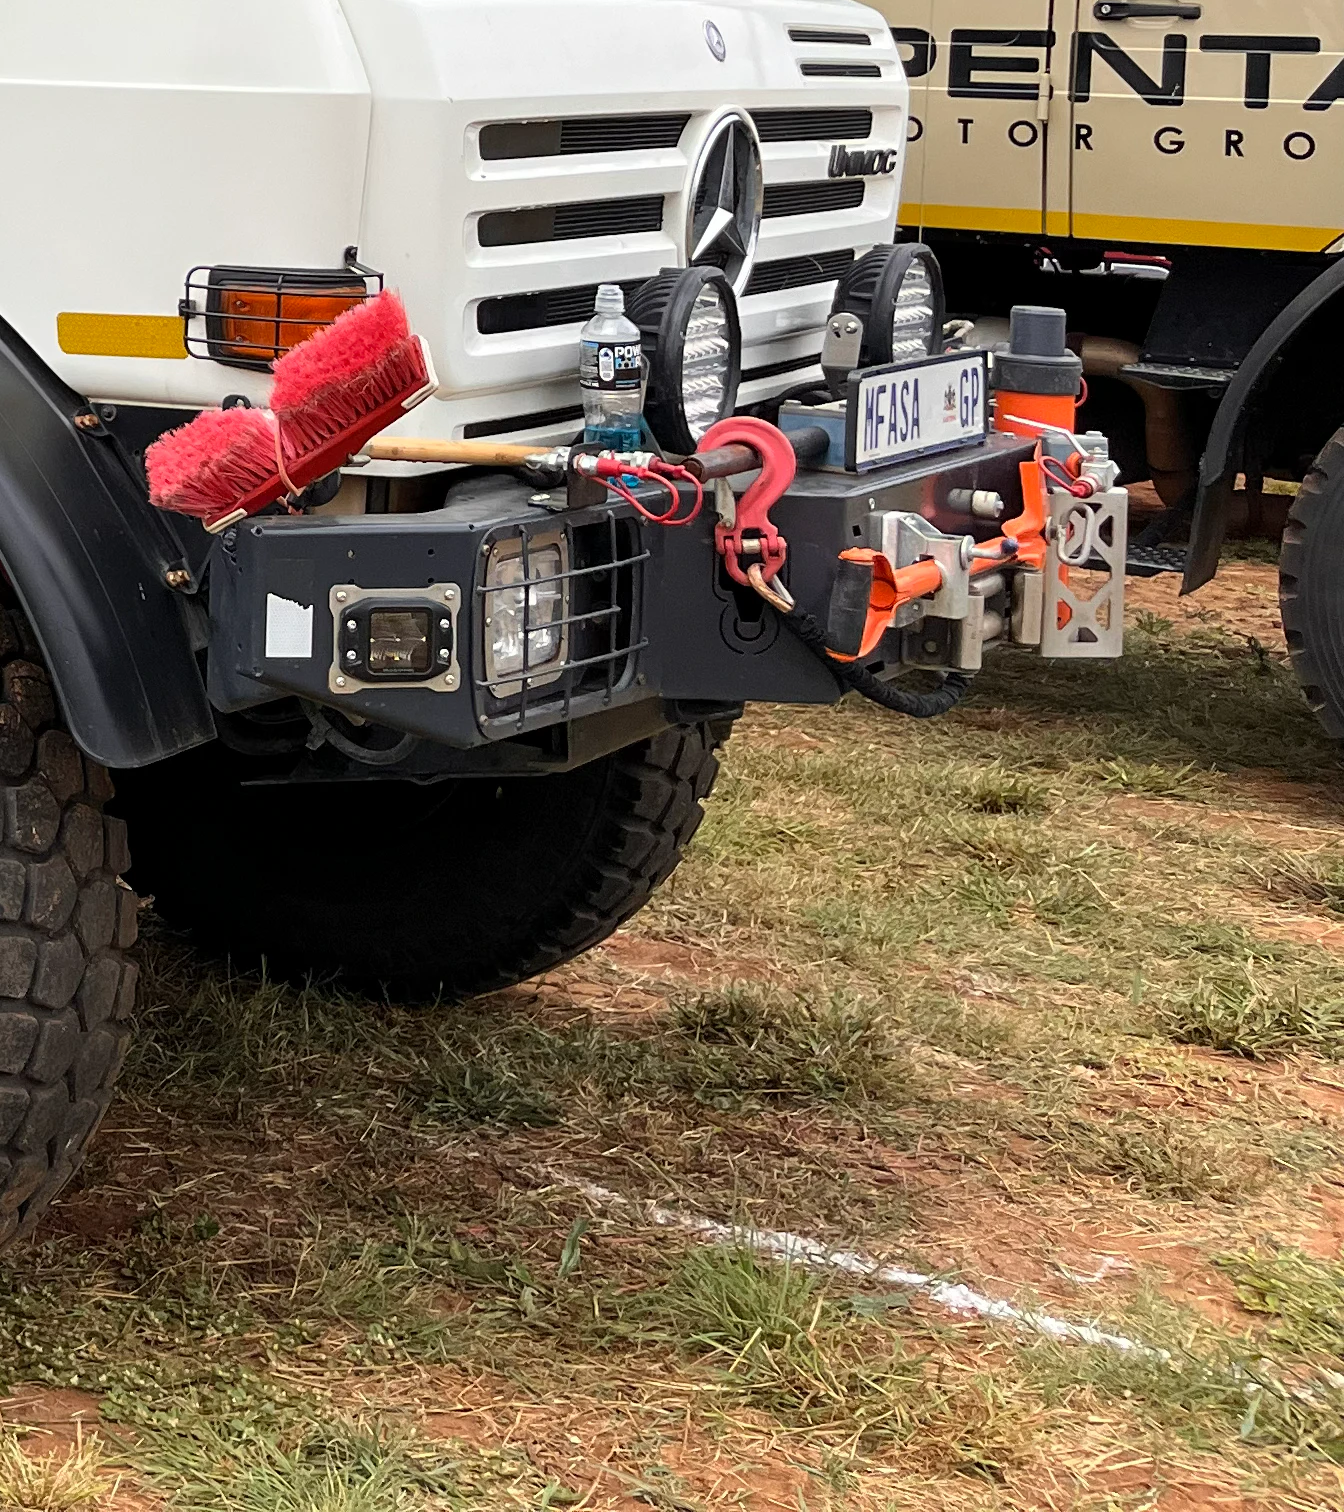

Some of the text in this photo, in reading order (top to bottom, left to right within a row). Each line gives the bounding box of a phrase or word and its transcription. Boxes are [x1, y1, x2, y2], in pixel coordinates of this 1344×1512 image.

[1153, 126, 1316, 161] GRO
[863, 367, 980, 452] MFASA GP
